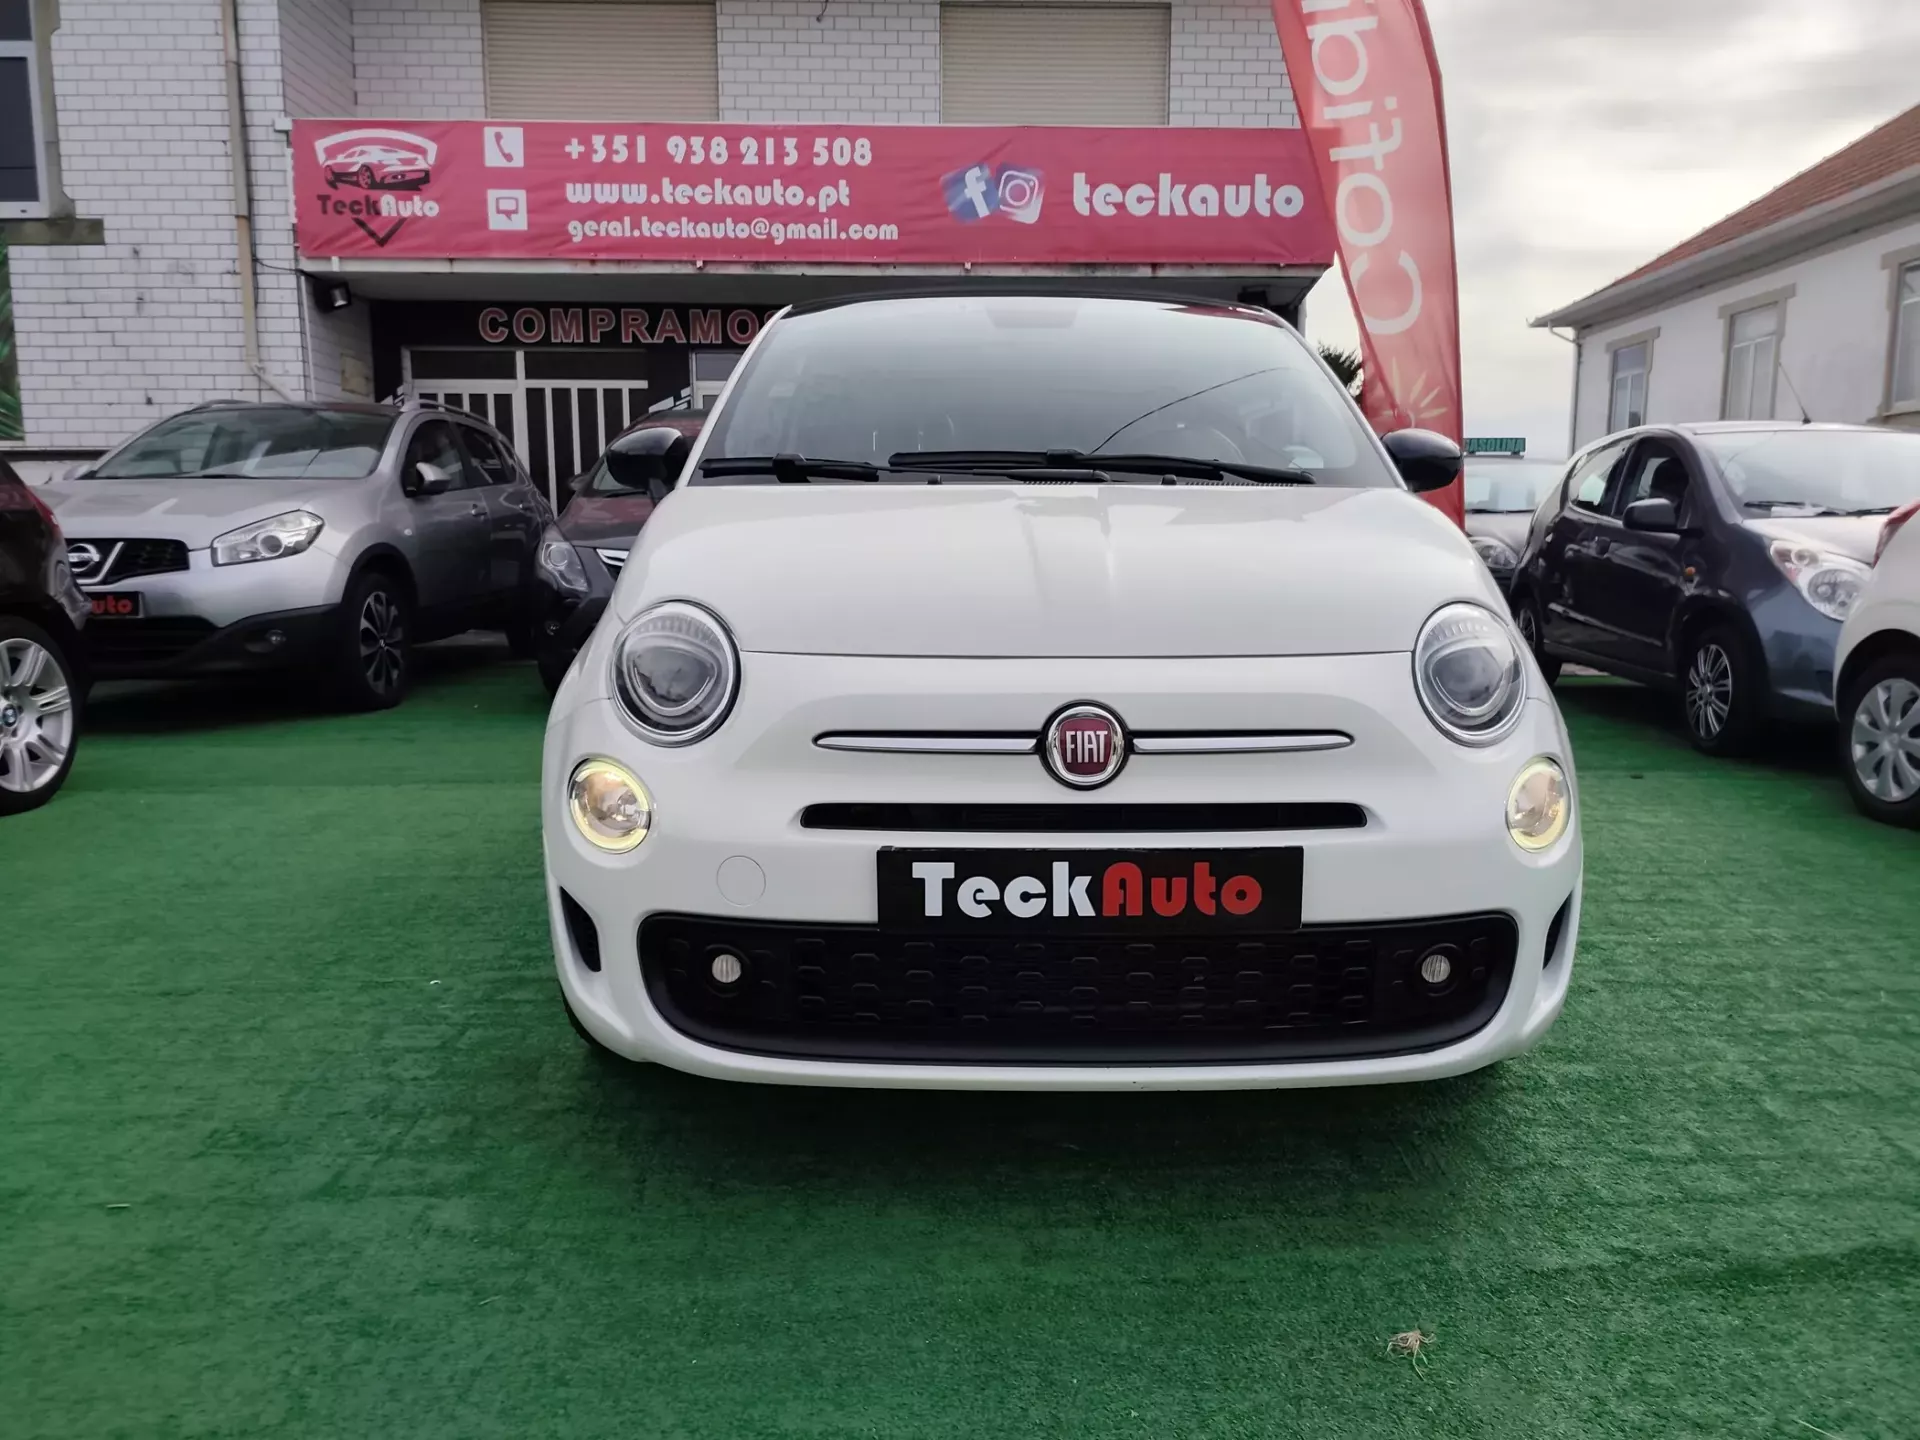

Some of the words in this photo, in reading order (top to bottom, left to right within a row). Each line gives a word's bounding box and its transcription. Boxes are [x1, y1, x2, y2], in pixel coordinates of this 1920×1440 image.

[565, 135, 646, 163] +351
[667, 136, 728, 165] 938
[740, 137, 798, 166] 213
[813, 138, 872, 166] 508
[317, 194, 440, 217] TeckAuto
[566, 177, 850, 212] www.teckauto.pt
[1073, 172, 1304, 217] teckauto
[568, 216, 898, 245] geral.teckauto@gmail.com
[479, 307, 778, 344] COMPRAMO
[1065, 730, 1108, 763] FIAT
[912, 862, 1262, 918] TeckAuto
